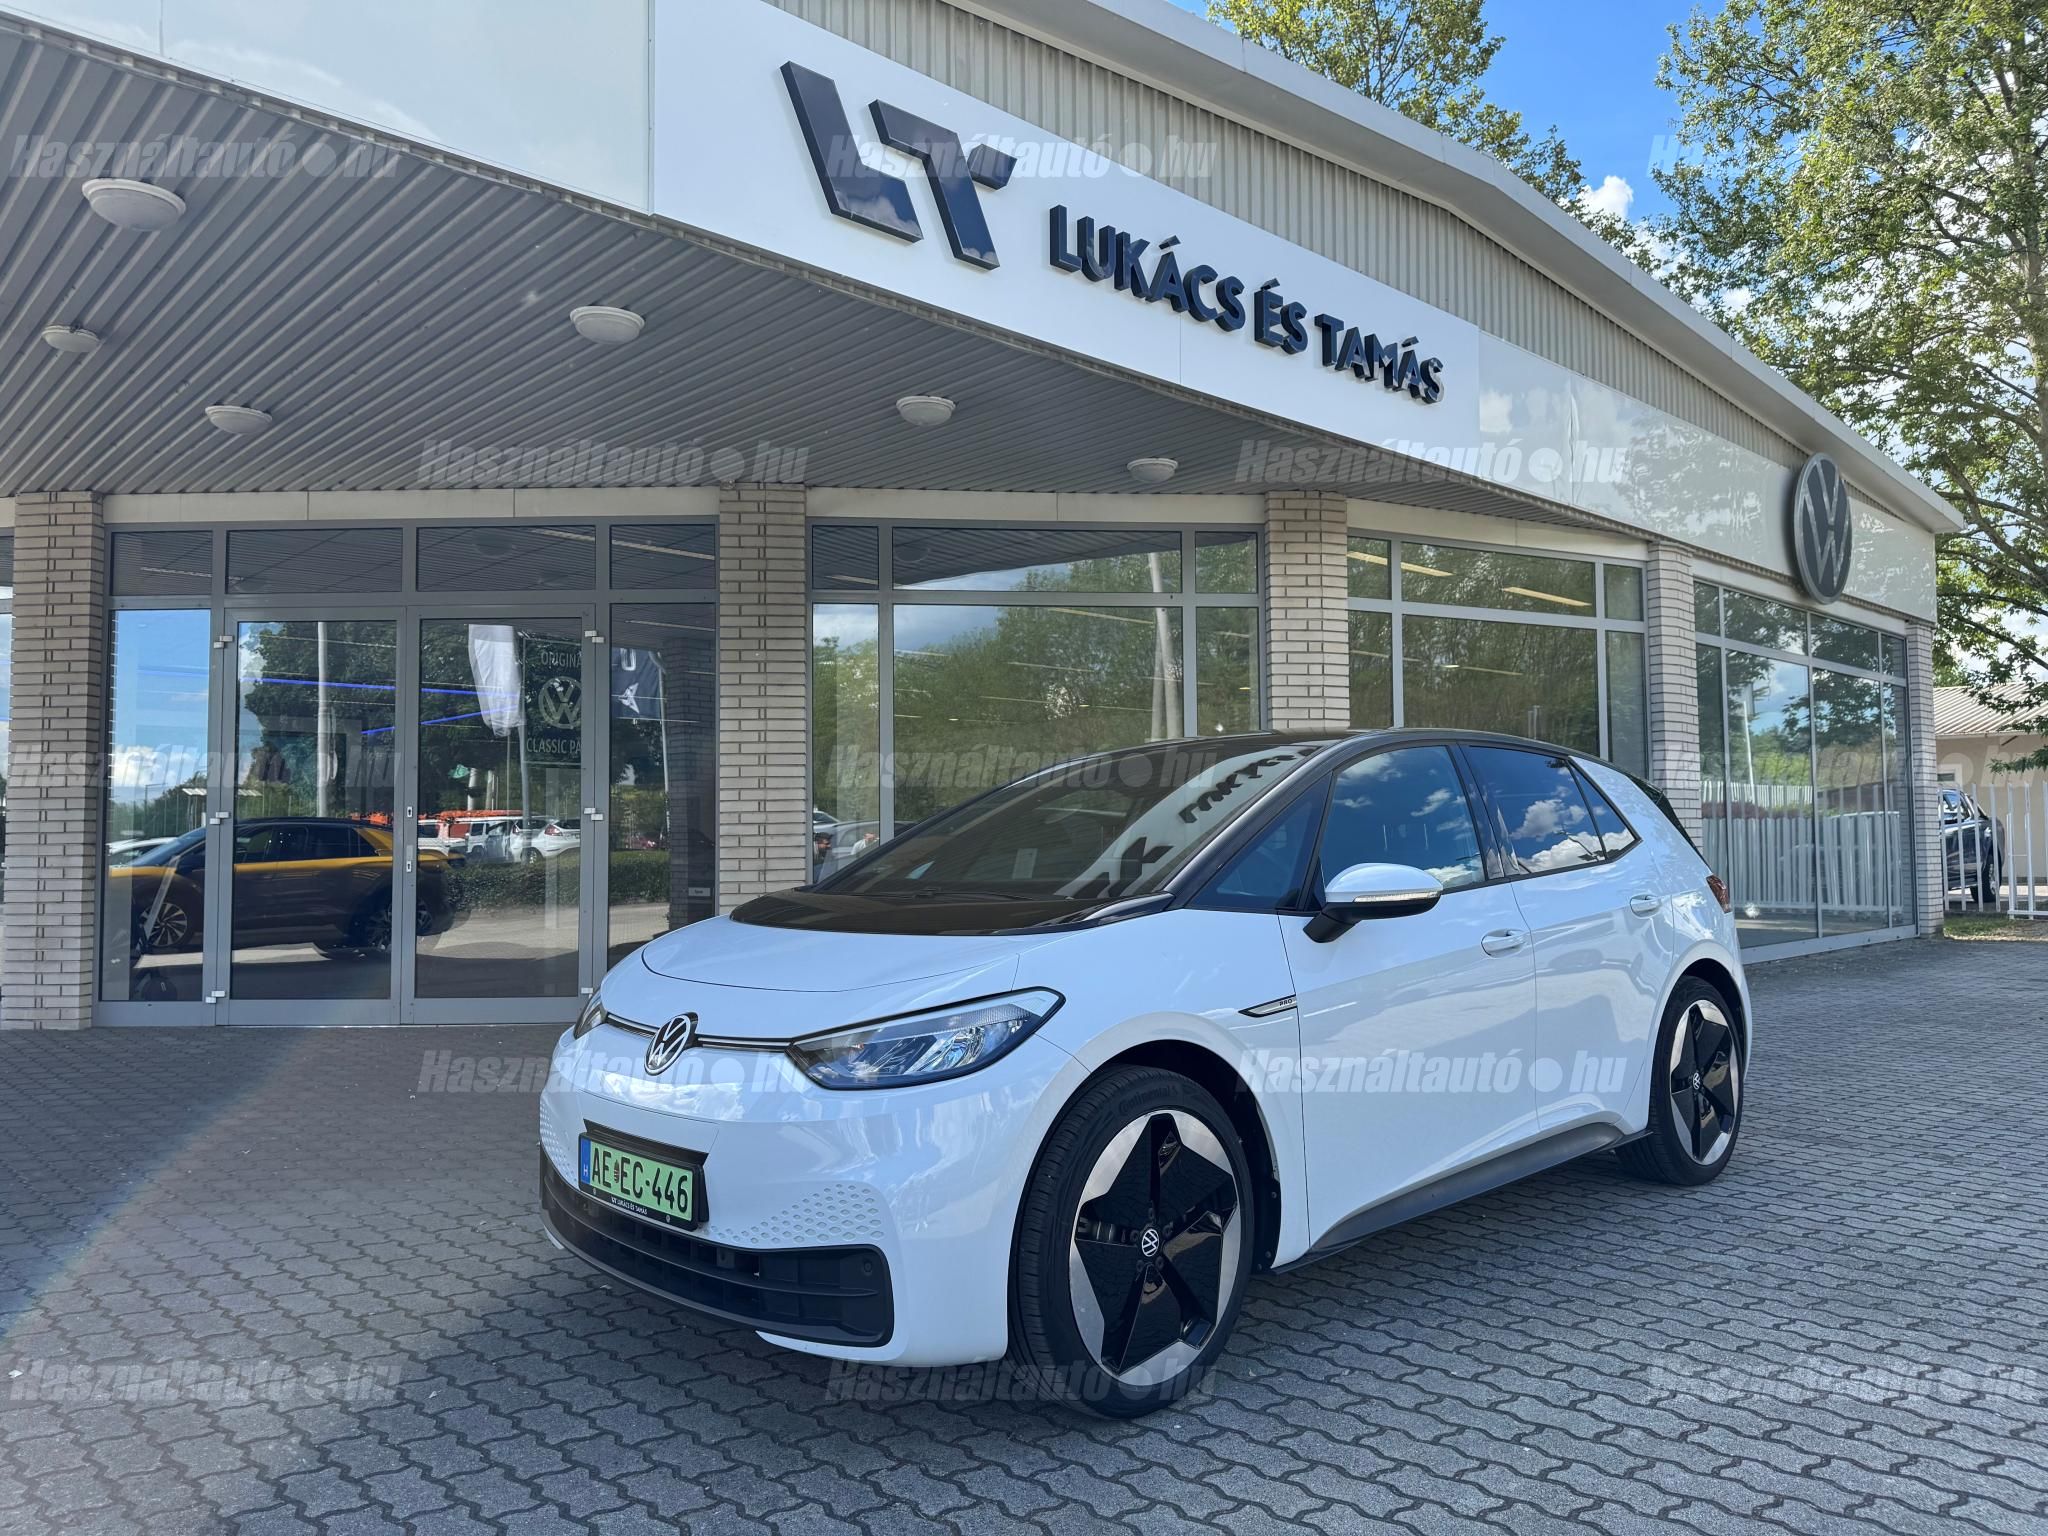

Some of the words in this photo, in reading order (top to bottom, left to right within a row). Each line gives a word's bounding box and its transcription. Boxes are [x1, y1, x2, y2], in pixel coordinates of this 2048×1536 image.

[1050, 205, 1247, 333] LUKÁCS
[1254, 277, 1309, 354] ÉS
[1314, 313, 1445, 404] TAMÁS
[526, 738, 567, 754] CLASSIC
